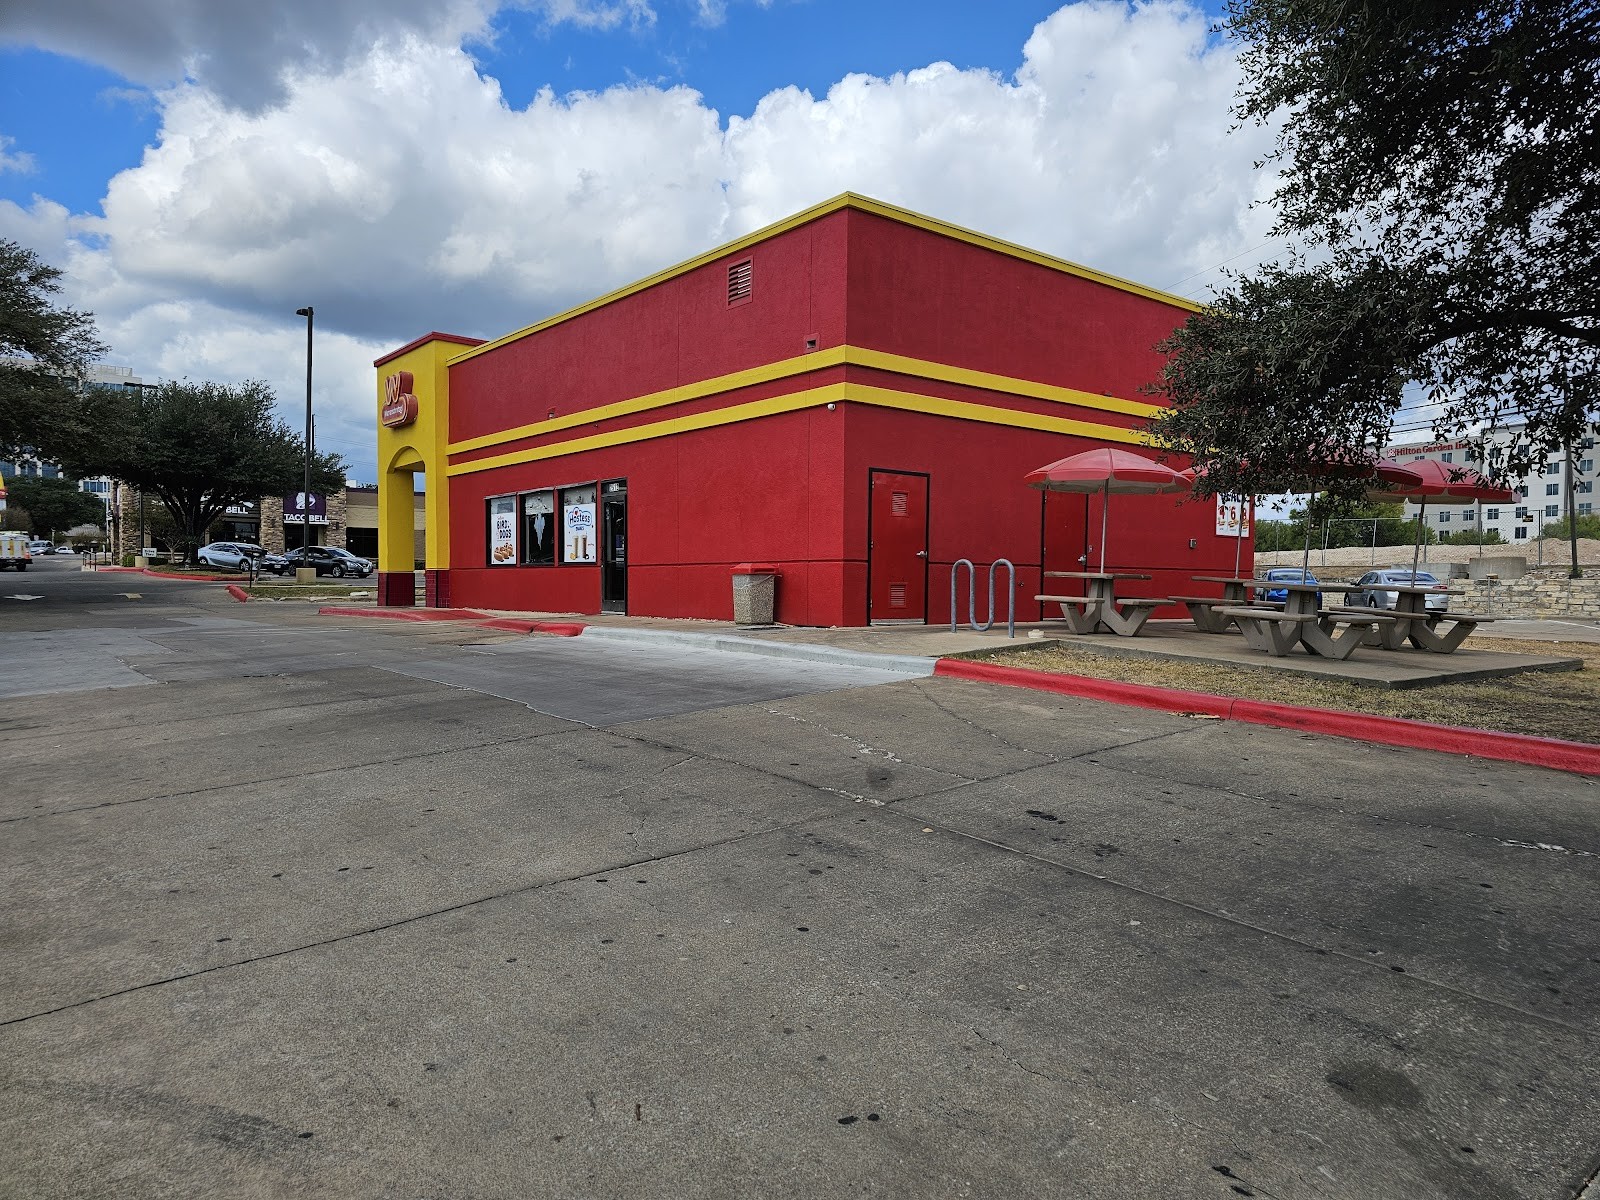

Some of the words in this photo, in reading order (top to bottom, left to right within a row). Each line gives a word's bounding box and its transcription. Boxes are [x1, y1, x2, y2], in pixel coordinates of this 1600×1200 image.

[1396, 447, 1422, 456] Hilton
[1422, 443, 1453, 453] Garden
[225, 506, 249, 515] BELL
[284, 513, 305, 521] TACO
[308, 514, 330, 522] BELL
[569, 513, 591, 525] Hostess
